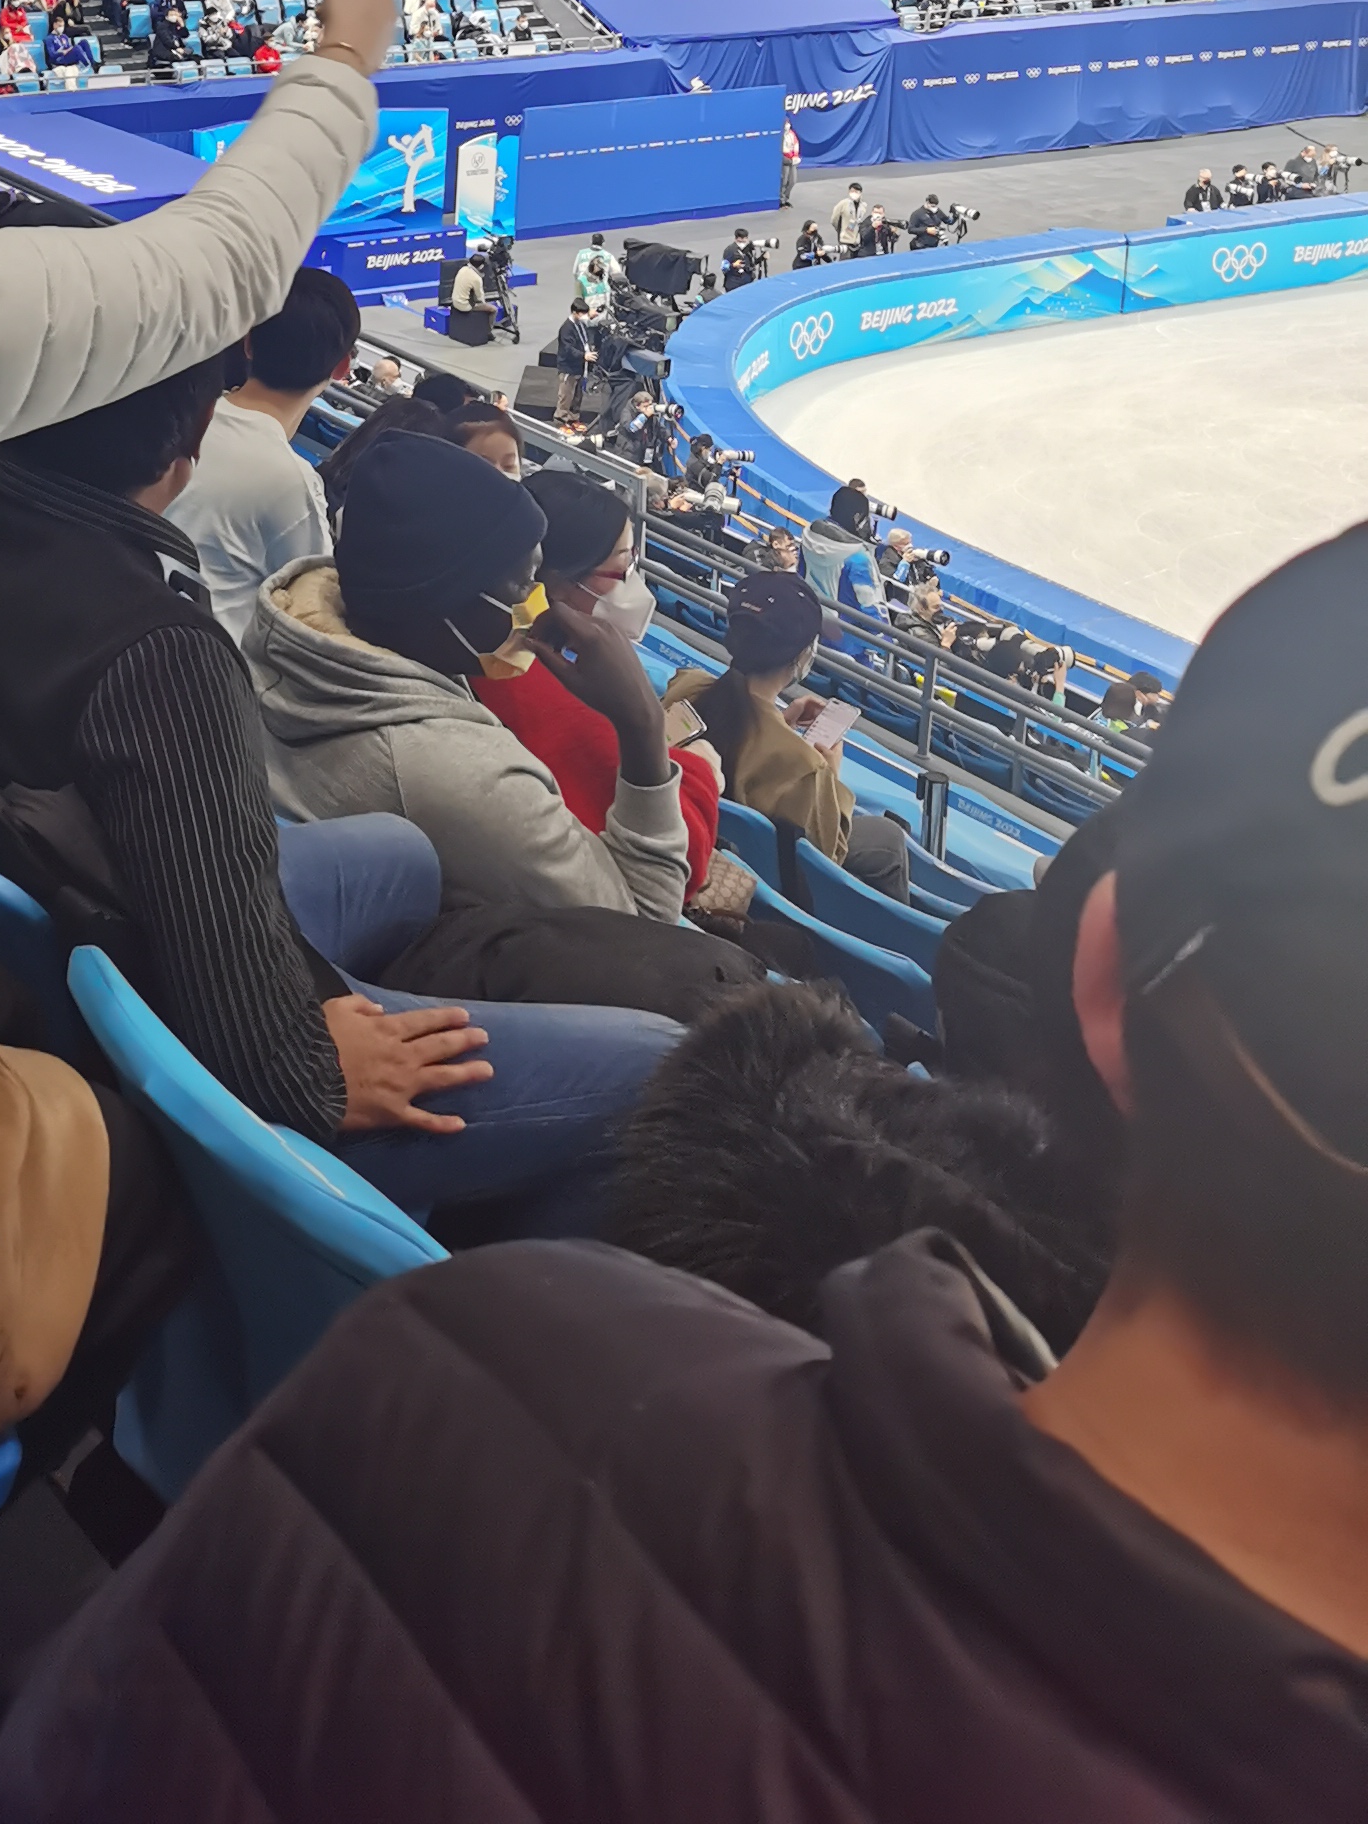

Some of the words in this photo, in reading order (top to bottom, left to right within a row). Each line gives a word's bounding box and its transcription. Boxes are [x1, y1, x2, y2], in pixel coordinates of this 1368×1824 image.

[784, 91, 830, 115] EIJING
[27, 157, 137, 194] BEIJING
[365, 251, 411, 271] BEIJING
[411, 247, 446, 264] 2022
[1293, 241, 1343, 266] BEIJING
[1344, 237, 1368, 256] 202
[860, 305, 915, 332] BEIJING
[915, 297, 959, 321] 2022
[957, 796, 994, 826] BEIJING
[993, 817, 1021, 841] 2022
